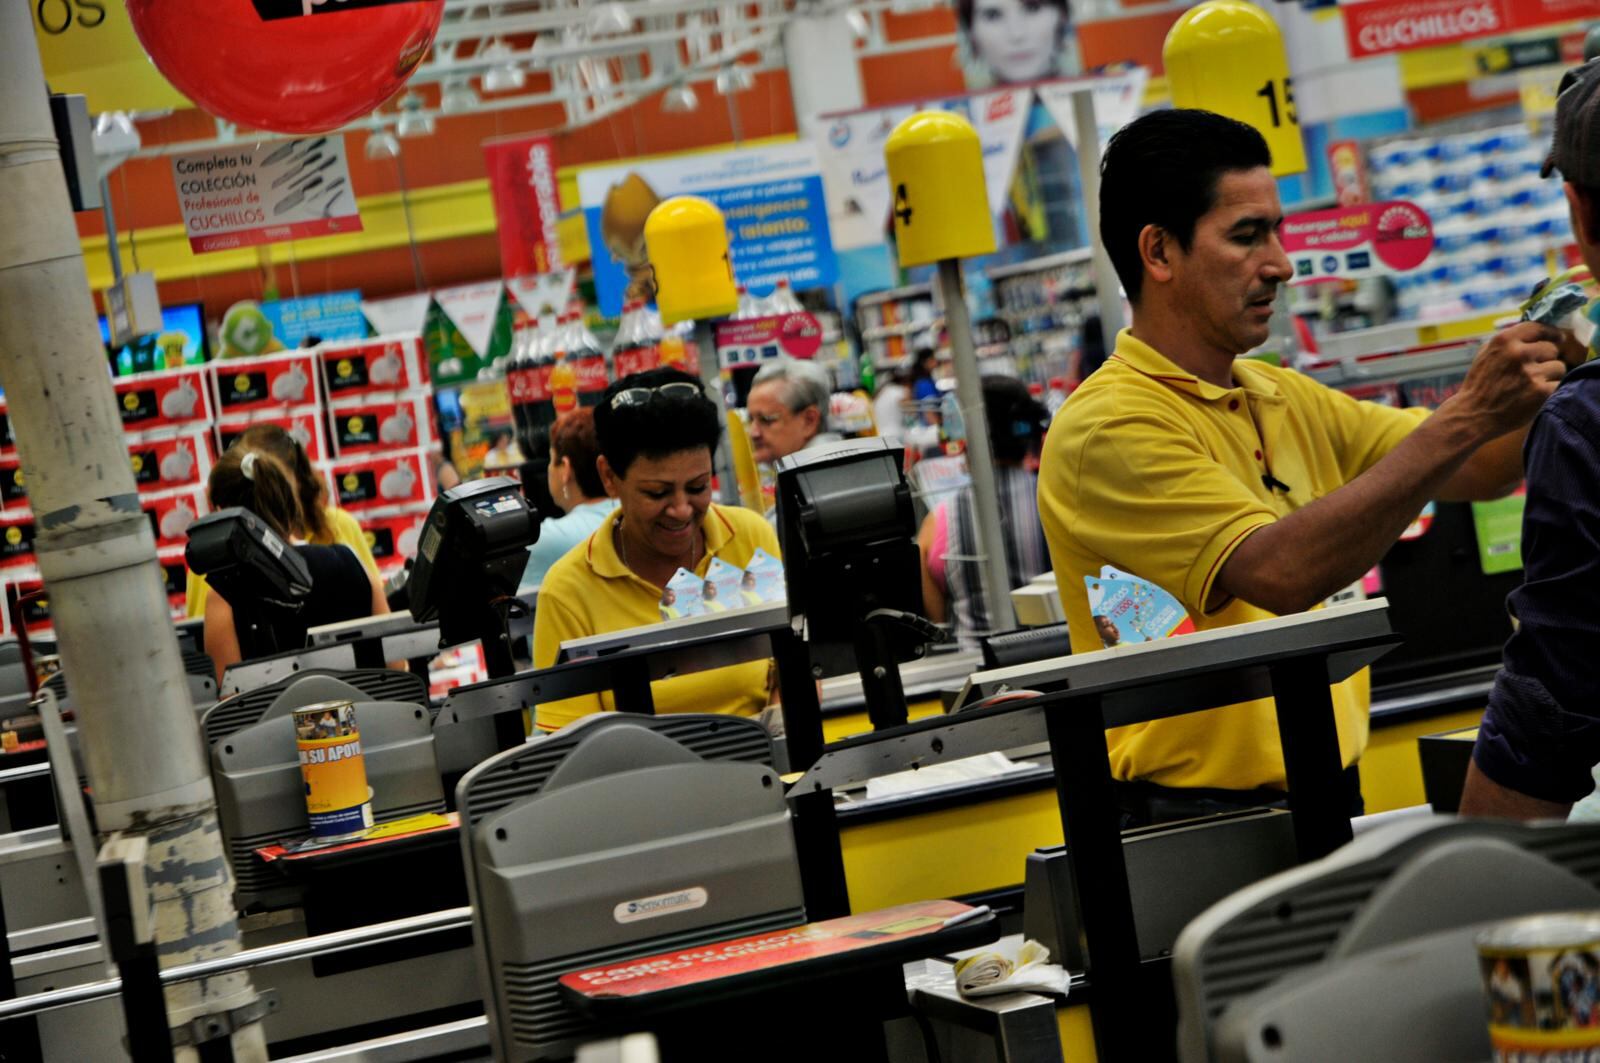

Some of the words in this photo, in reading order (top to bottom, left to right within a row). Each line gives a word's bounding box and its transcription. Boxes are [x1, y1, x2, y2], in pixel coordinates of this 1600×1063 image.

[1358, 6, 1499, 51] CUCHILLOS
[176, 155, 237, 175] Completa
[240, 154, 253, 166] tu
[181, 172, 257, 196] COLECCIÓN
[184, 193, 243, 211] Profesional
[246, 191, 260, 204] de
[189, 208, 265, 232] CUCHILLOS
[310, 747, 326, 765] SU
[590, 961, 694, 986] como
